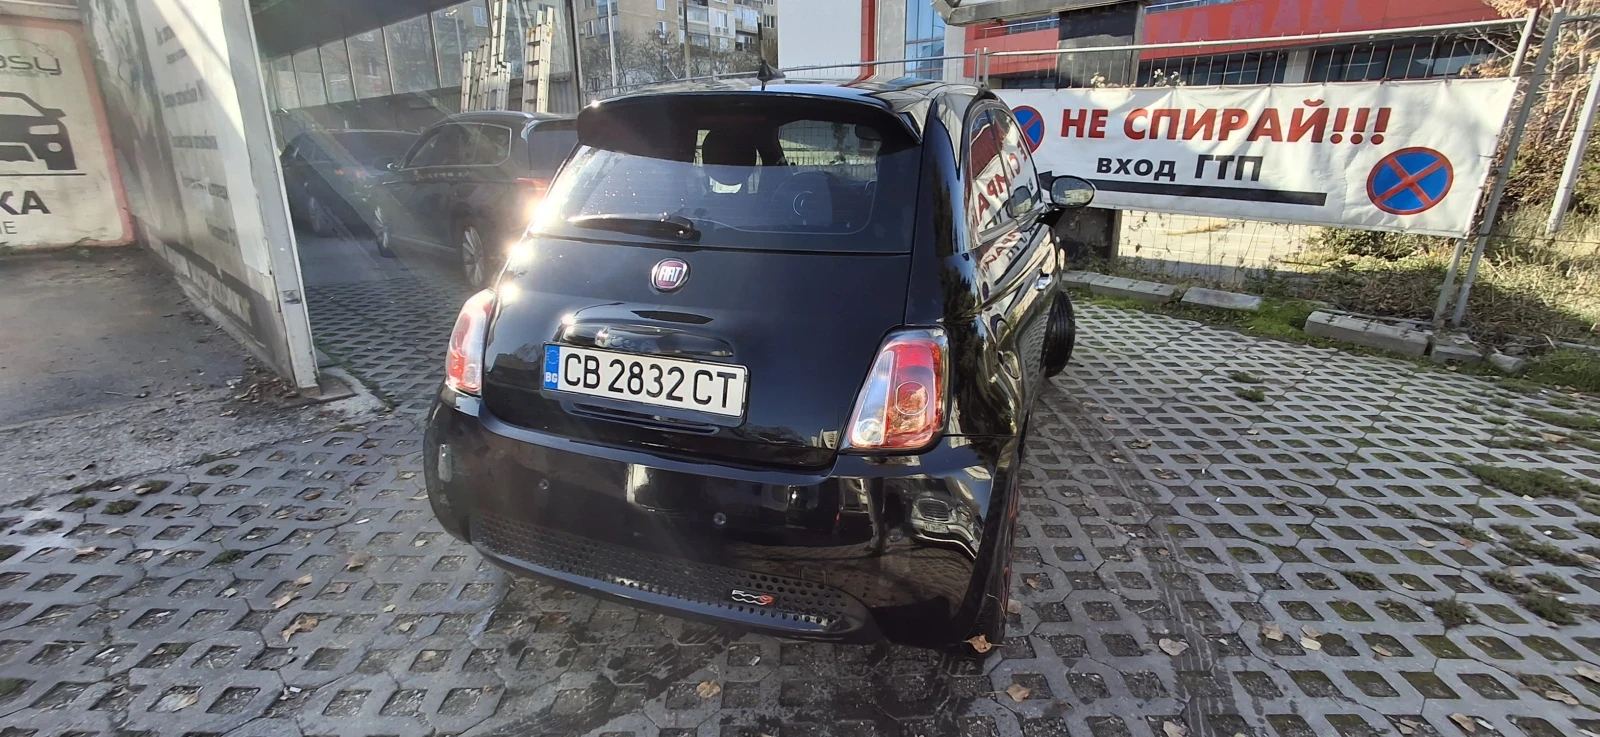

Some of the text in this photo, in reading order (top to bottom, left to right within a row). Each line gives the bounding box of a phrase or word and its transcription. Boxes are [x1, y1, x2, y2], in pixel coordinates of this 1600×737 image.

[1060, 98, 1392, 145] НЕ СПИРАЙ!!!
[1194, 154, 1264, 182] ГТП
[657, 265, 683, 283] FIAT
[545, 371, 558, 384] BG
[563, 352, 738, 409] CB 2832 CT
